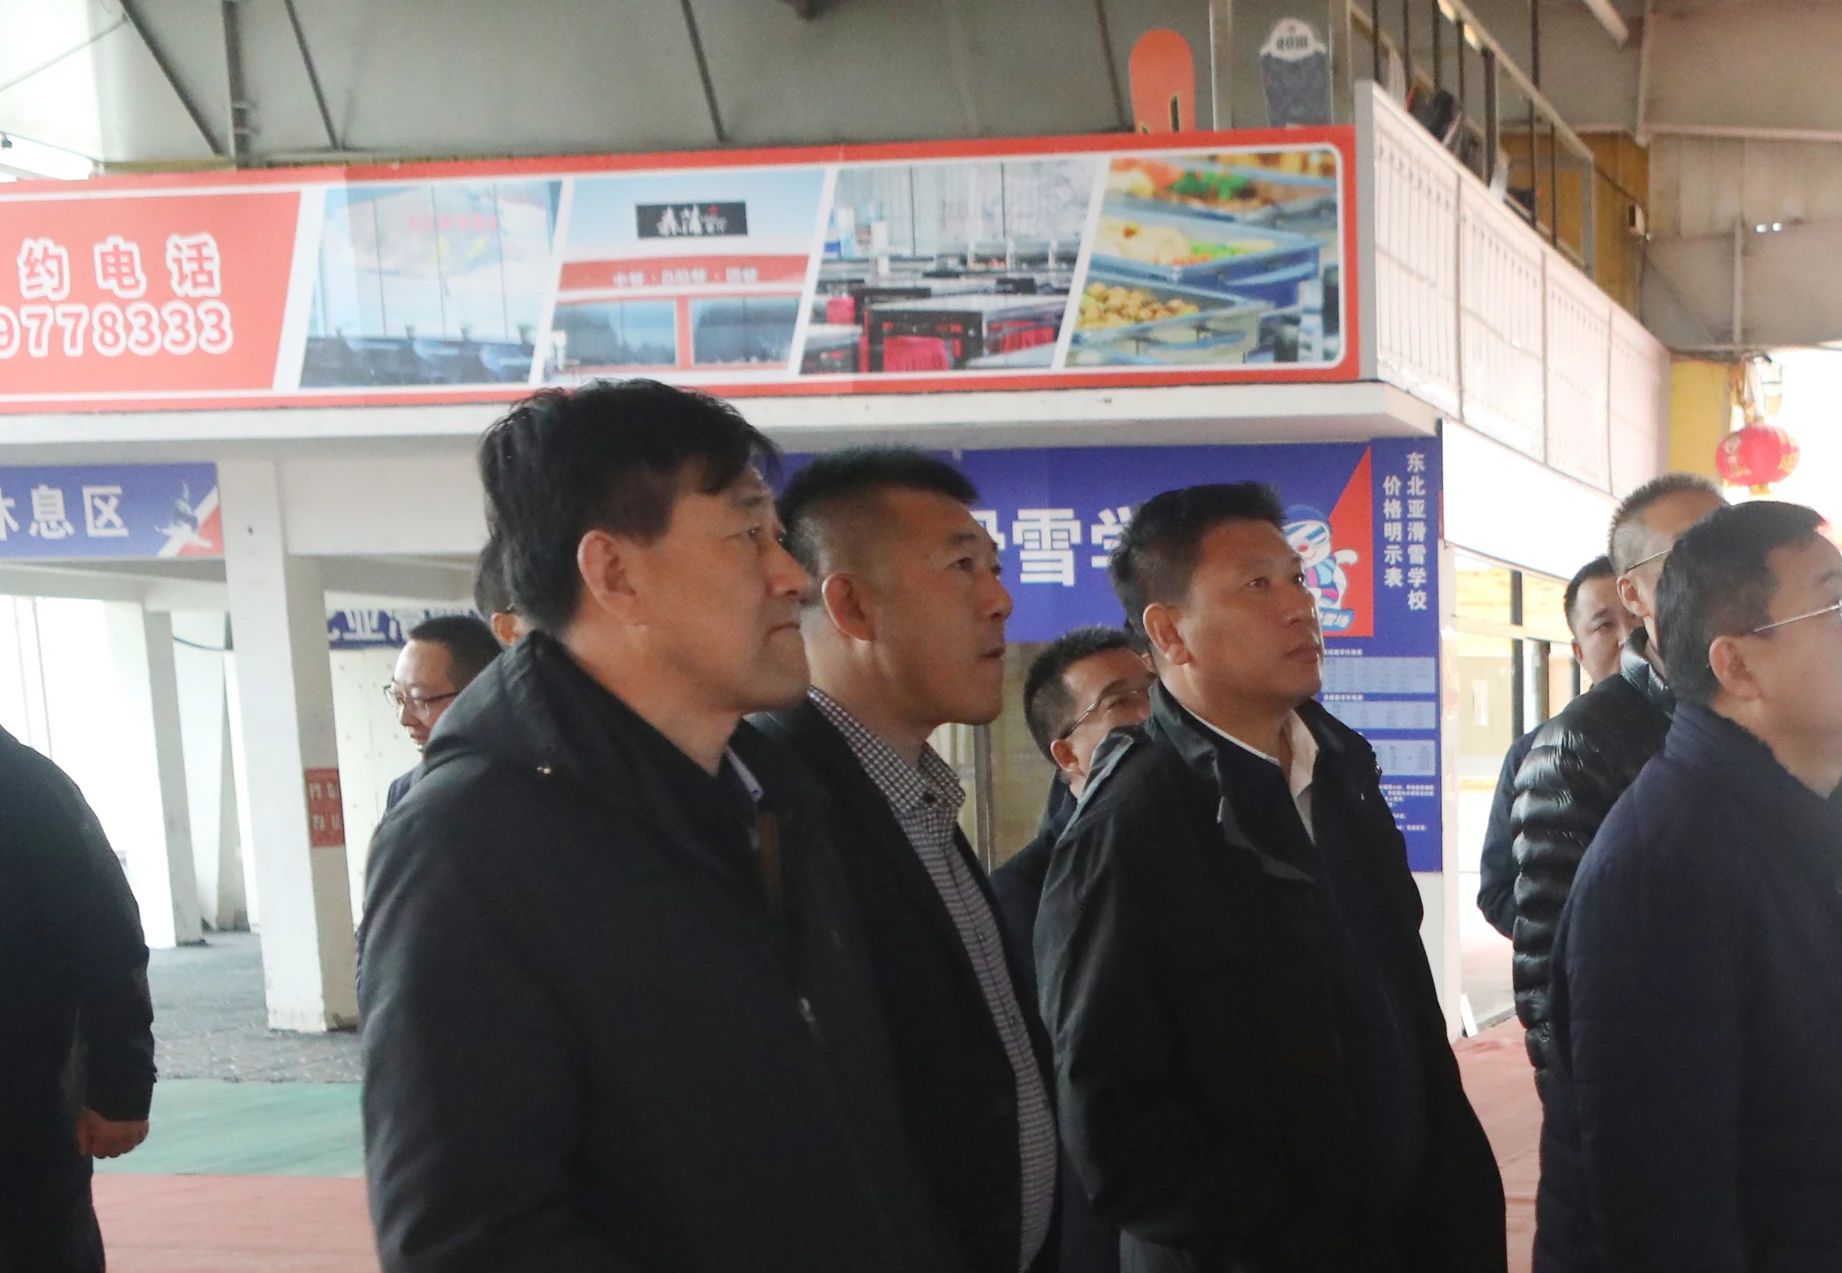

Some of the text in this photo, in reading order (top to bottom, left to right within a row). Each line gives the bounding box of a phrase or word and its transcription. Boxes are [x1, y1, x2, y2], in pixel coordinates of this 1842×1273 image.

[0, 299, 234, 359] 9778333
[1382, 475, 1404, 588] 价格明示表
[1406, 452, 1428, 611] 东北亚滑雪学校
